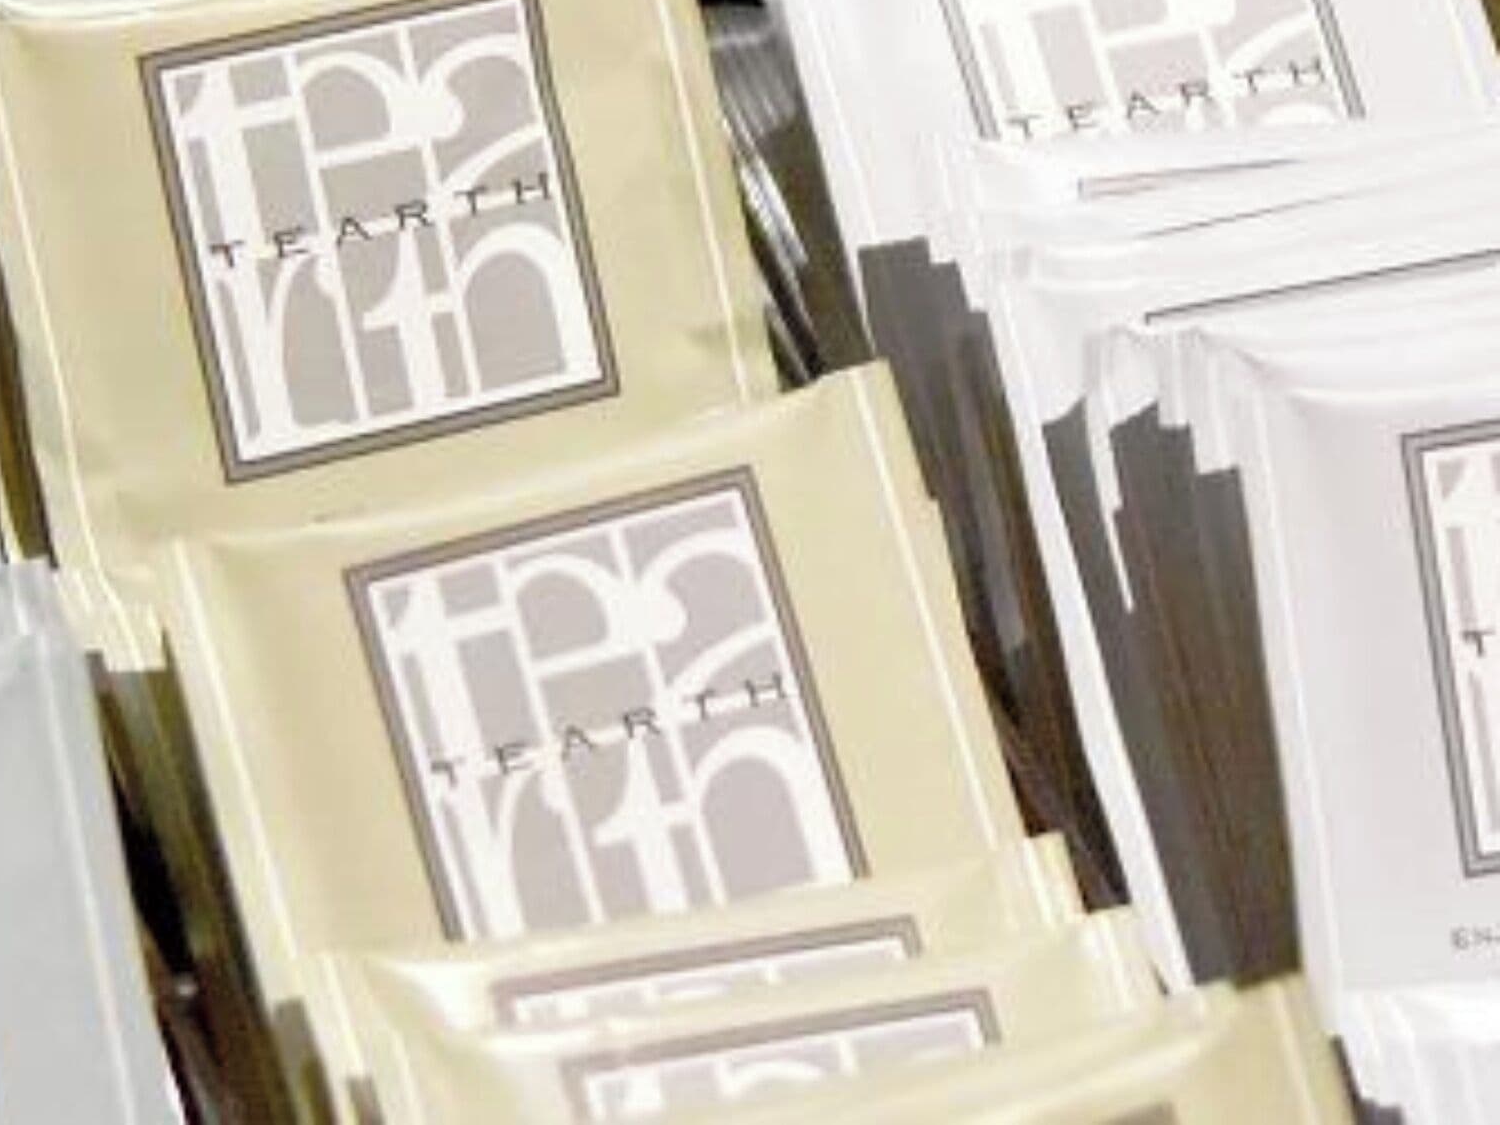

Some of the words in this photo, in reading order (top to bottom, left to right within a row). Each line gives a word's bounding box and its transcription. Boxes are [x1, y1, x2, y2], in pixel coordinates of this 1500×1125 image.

[1005, 56, 1326, 140] TEARTH
[211, 172, 554, 270] TEARTH
[431, 672, 788, 787] TEARTH
